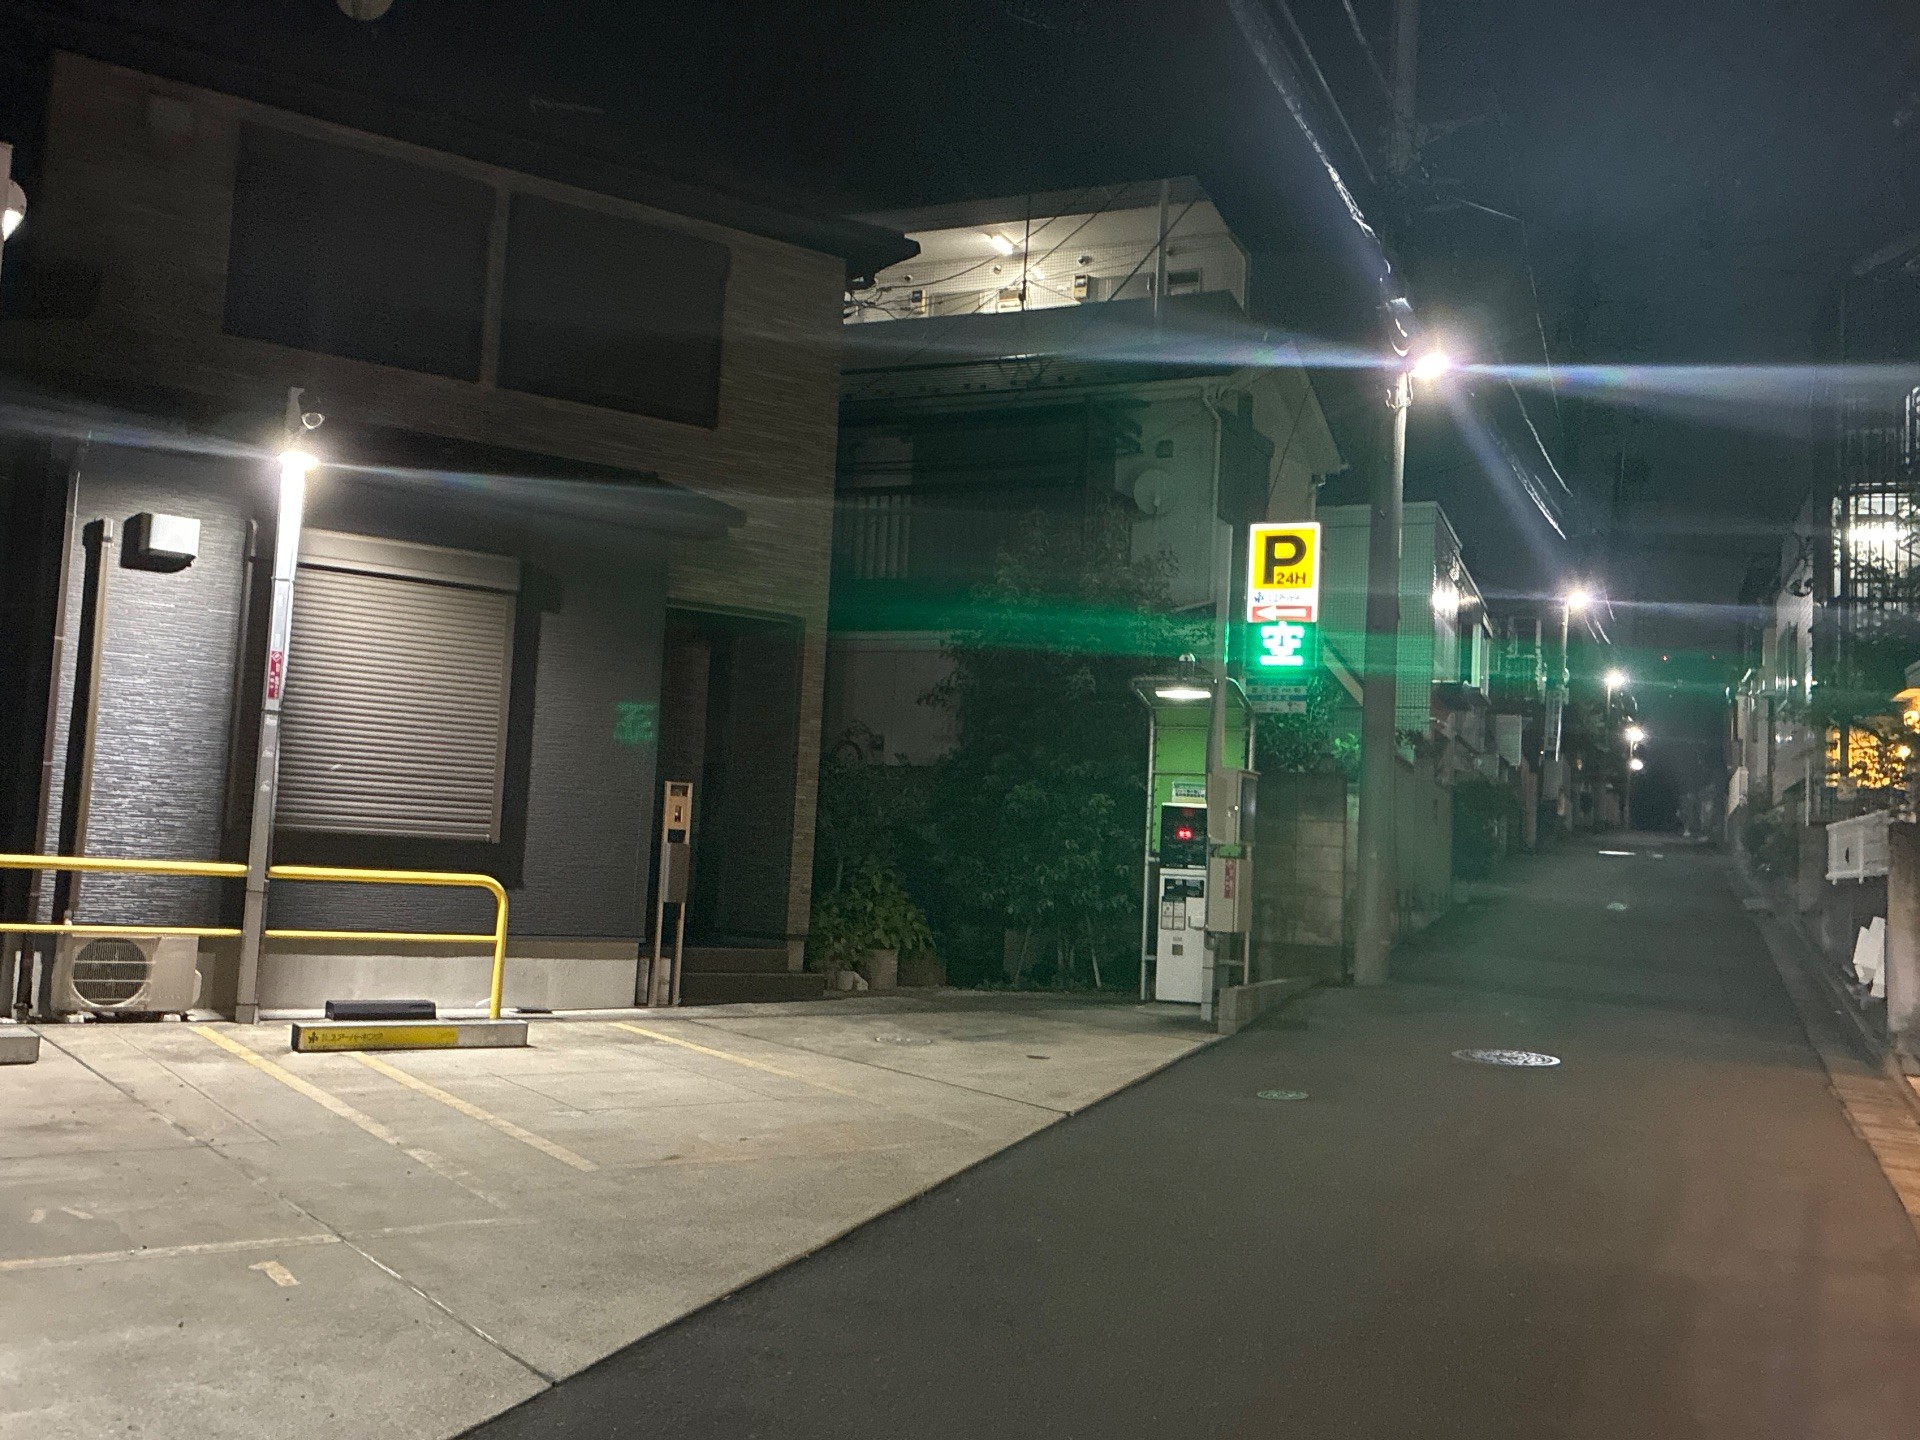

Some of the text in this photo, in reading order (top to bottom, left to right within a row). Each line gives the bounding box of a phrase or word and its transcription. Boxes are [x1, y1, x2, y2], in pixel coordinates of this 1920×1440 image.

[1263, 535, 1307, 584] P
[1276, 572, 1307, 585] 24H
[1260, 620, 1305, 666] 空
